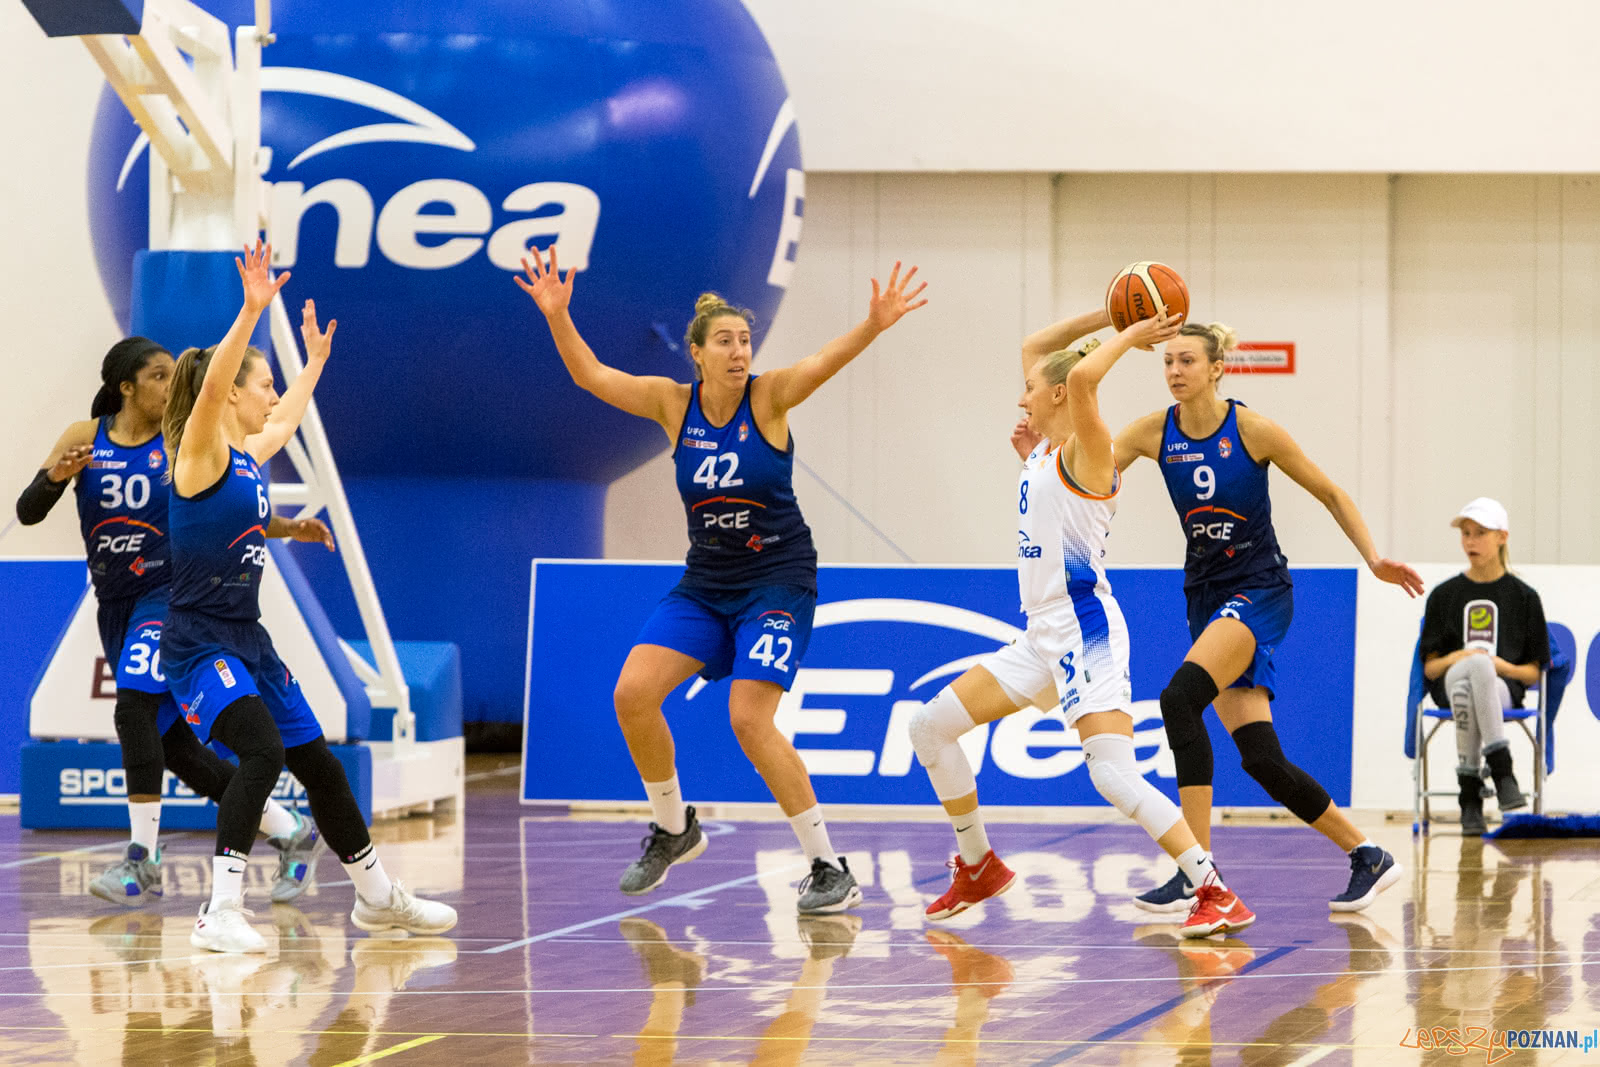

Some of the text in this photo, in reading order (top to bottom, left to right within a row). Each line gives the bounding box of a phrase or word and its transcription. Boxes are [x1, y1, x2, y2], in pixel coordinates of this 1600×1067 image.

[260, 148, 600, 272] nea
[693, 452, 744, 489] 42
[1193, 465, 1216, 500] 9
[100, 473, 151, 510] 30
[256, 483, 268, 518] 6
[1019, 480, 1029, 515] 8
[703, 509, 750, 529] PGE
[1192, 522, 1234, 540] PGE
[97, 533, 146, 553] PGE
[1018, 545, 1042, 559] nea
[763, 618, 791, 631] PGE
[748, 633, 793, 673] 42
